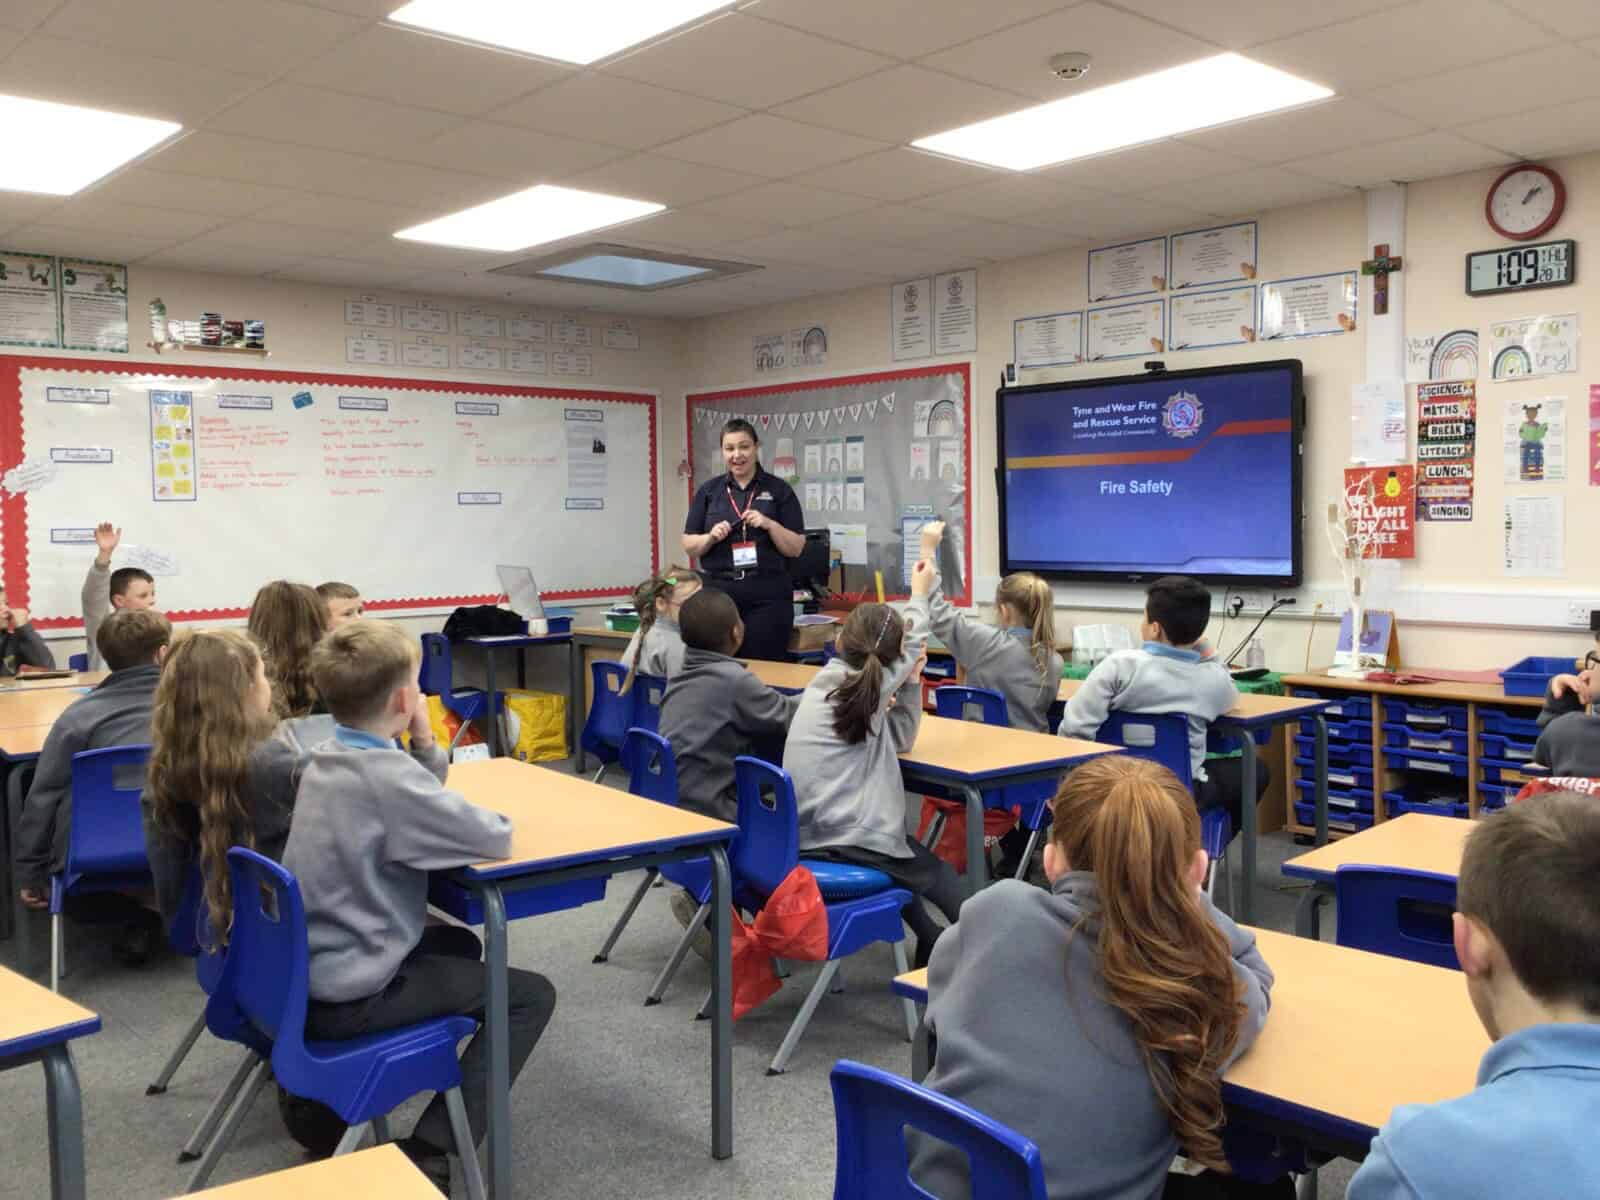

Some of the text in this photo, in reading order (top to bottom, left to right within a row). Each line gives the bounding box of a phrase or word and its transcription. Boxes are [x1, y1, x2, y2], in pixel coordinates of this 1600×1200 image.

[1497, 249, 1539, 286] 1:09
[1072, 401, 1157, 417] Tyne and Wear Fire
[1423, 404, 1459, 416] MATHS
[1072, 414, 1157, 428] and Rescue Service
[1431, 424, 1462, 435] BREAK
[1420, 446, 1463, 456] LITERACY
[1428, 465, 1464, 477] LUNCH
[1100, 480, 1174, 496] Fire Safety
[1431, 506, 1470, 516] SINGING
[1381, 520, 1409, 531] ALL
